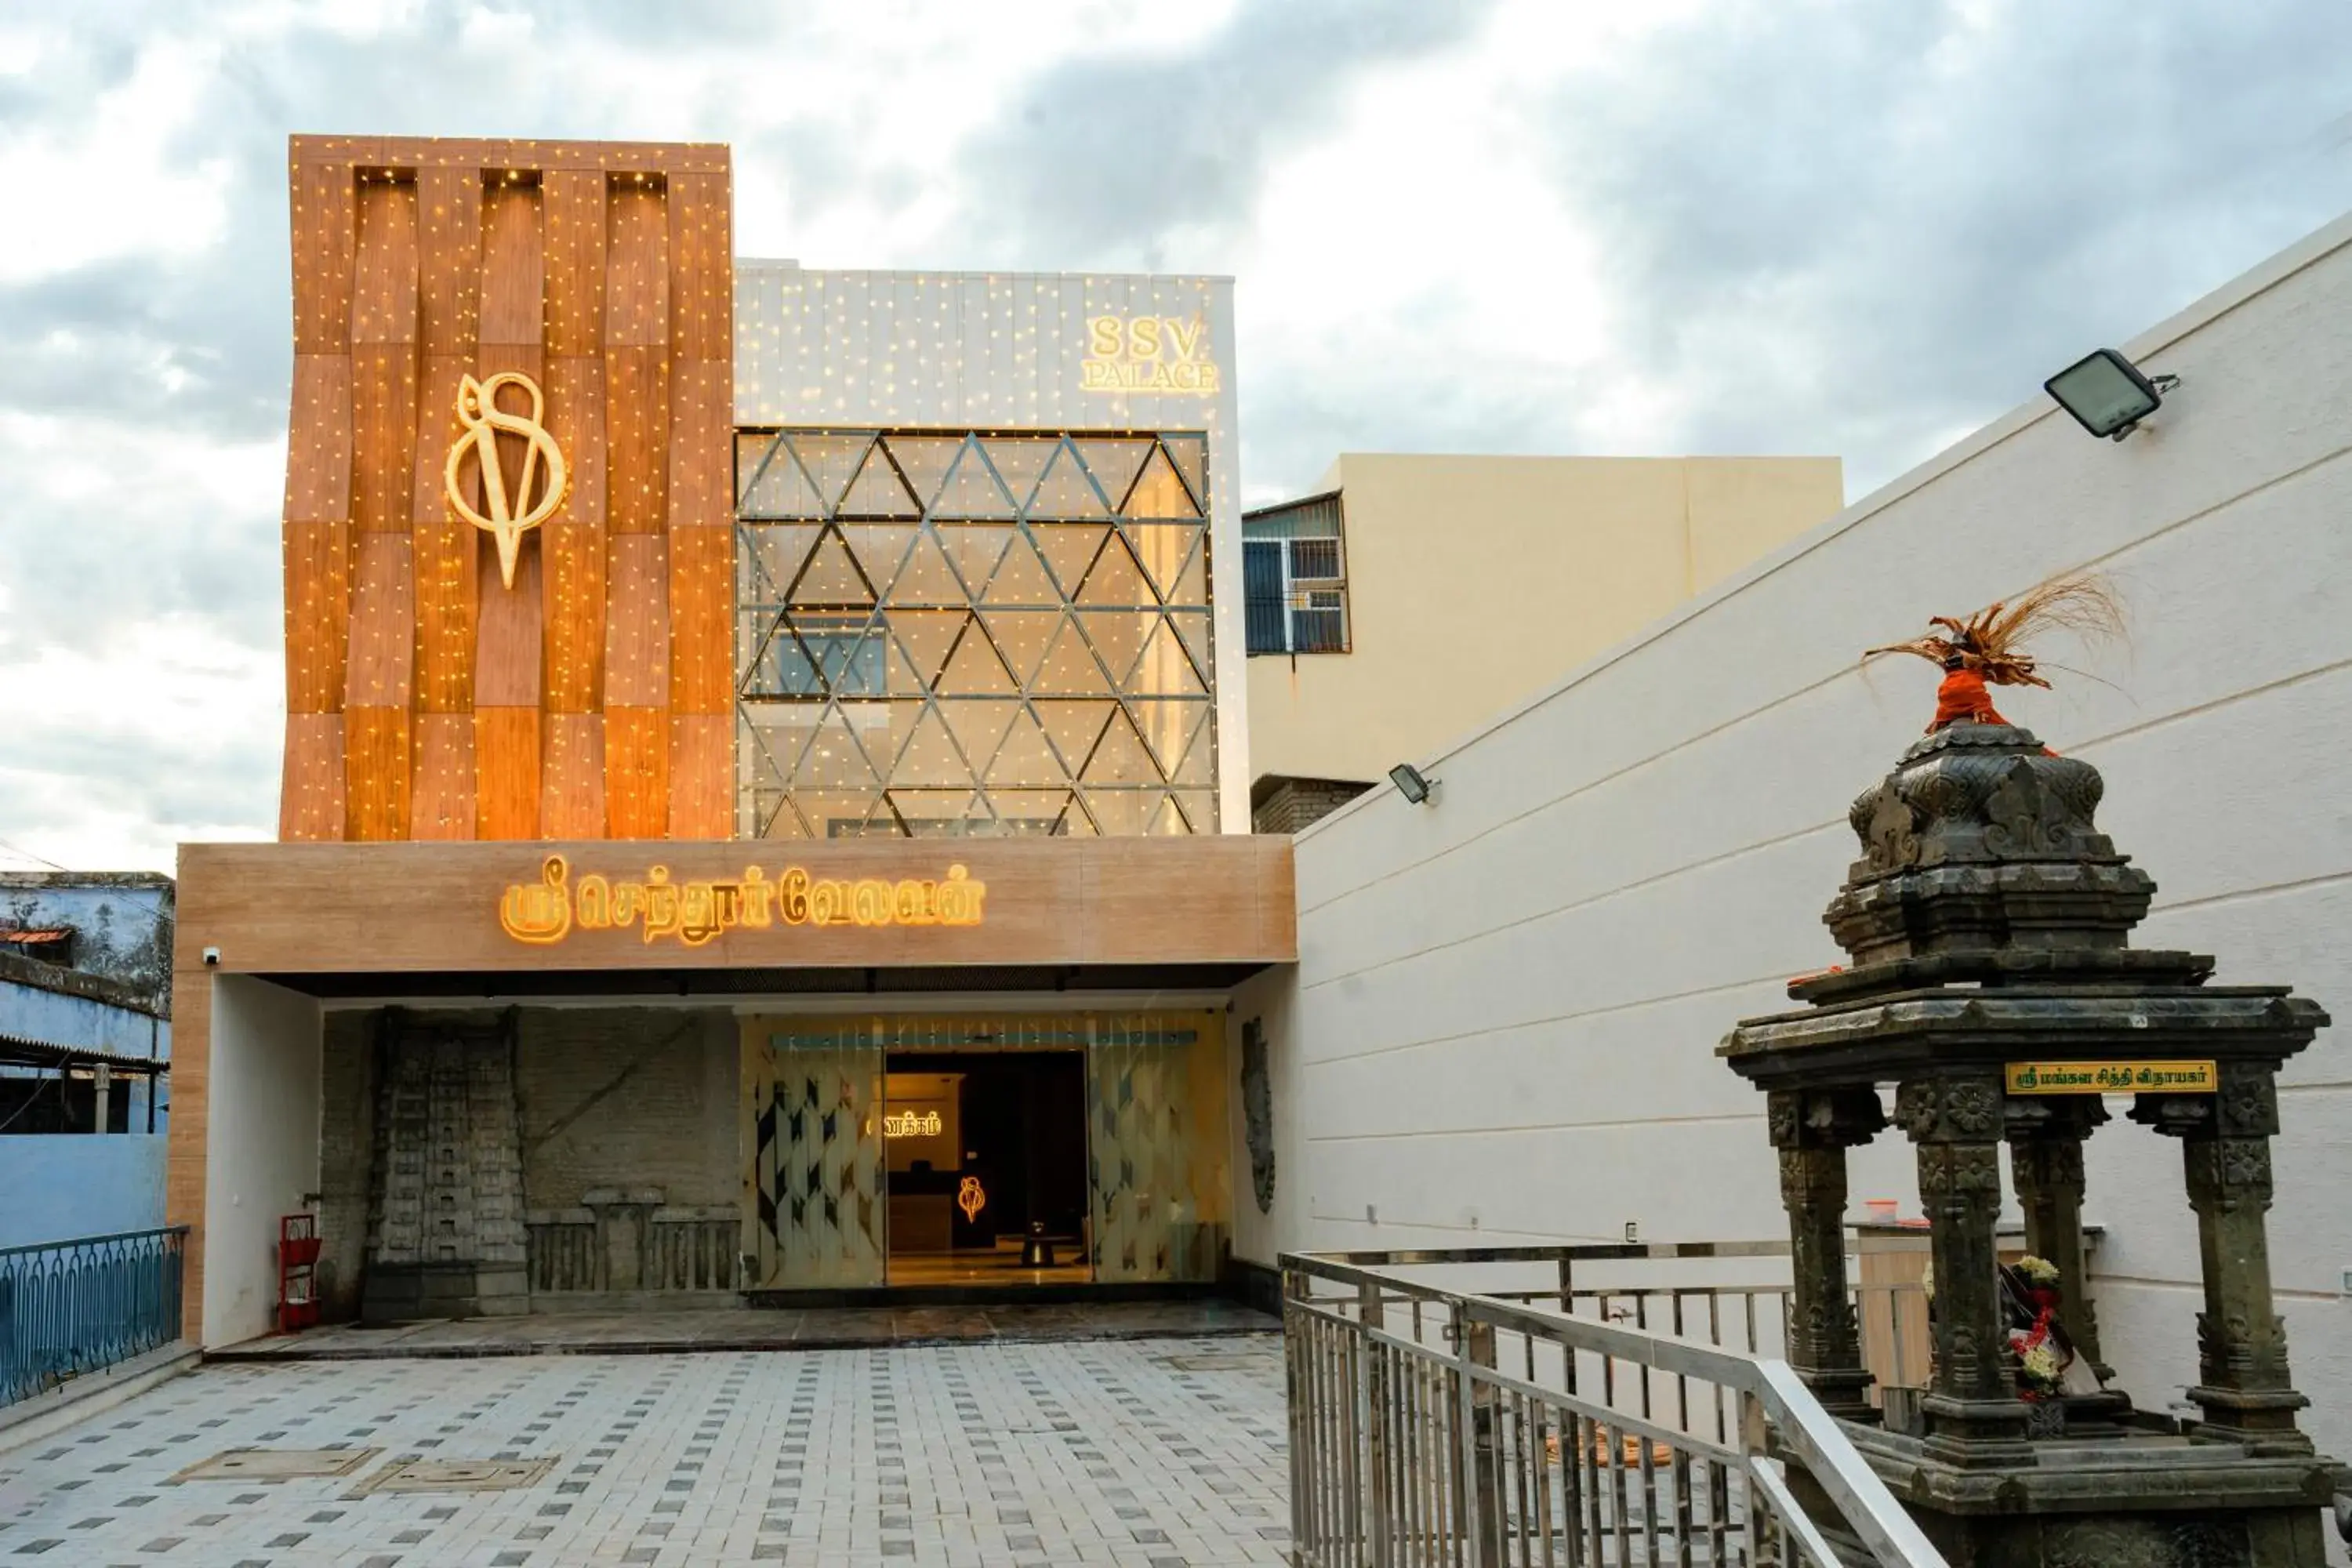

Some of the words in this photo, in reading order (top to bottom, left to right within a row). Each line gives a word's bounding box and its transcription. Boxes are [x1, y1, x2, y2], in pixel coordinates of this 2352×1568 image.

[1090, 316, 1202, 358] SSV
[1083, 360, 1219, 390] PALACE
[577, 866, 772, 945] செந்தூர்
[782, 864, 985, 926] வேலவன்
[2096, 1067, 2133, 1087] சித்தி
[2136, 1065, 2208, 1086] விநாயகர்
[866, 1110, 942, 1136] ணக்கம்
